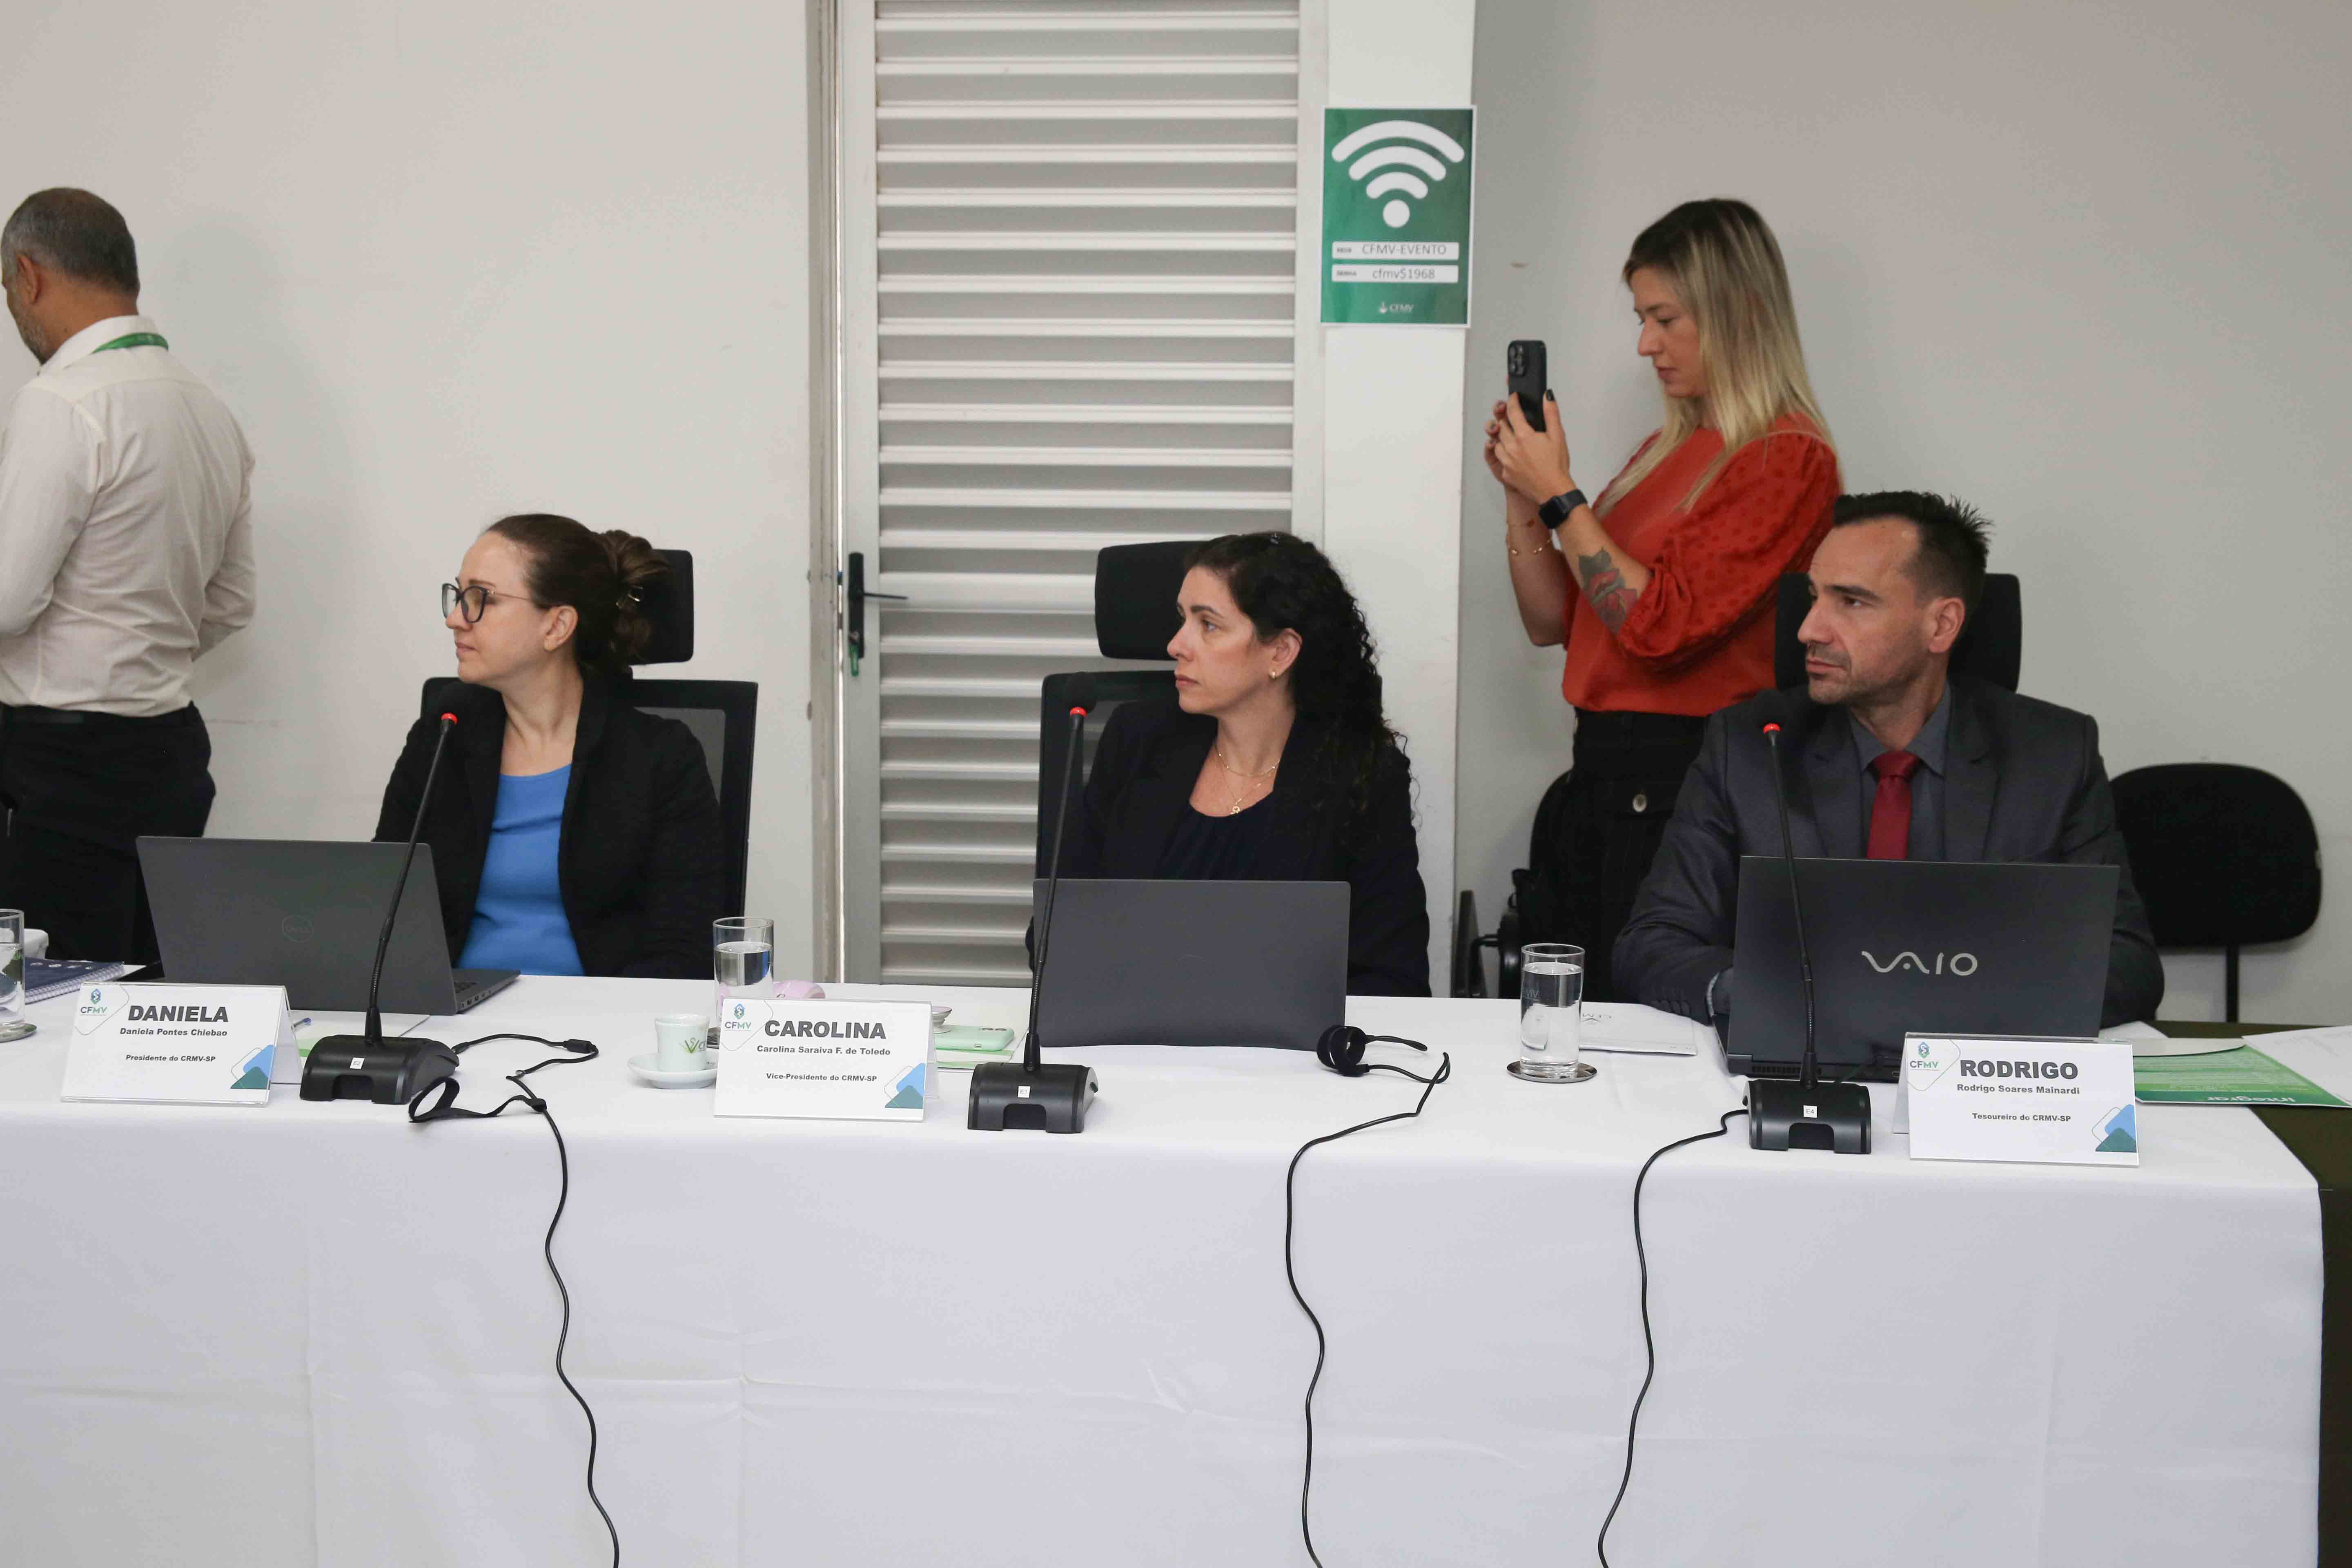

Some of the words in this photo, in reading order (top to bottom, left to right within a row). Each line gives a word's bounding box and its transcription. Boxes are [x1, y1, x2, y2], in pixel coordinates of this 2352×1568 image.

[1362, 244, 1447, 254] CFMV-EVENTO
[1372, 268, 1435, 280] cfmv$1968
[1389, 303, 1414, 313] CFMV
[1861, 951, 1978, 976] VAIO
[128, 1005, 229, 1022] DANIELA
[725, 1021, 752, 1029] CFMV
[765, 1020, 886, 1039] CAROLINA
[1960, 1060, 2078, 1080] RODRIGO
[1957, 1084, 1996, 1094] Rodrigo
[1998, 1085, 2033, 1093] Soares
[2036, 1086, 2080, 1094] Mainardi
